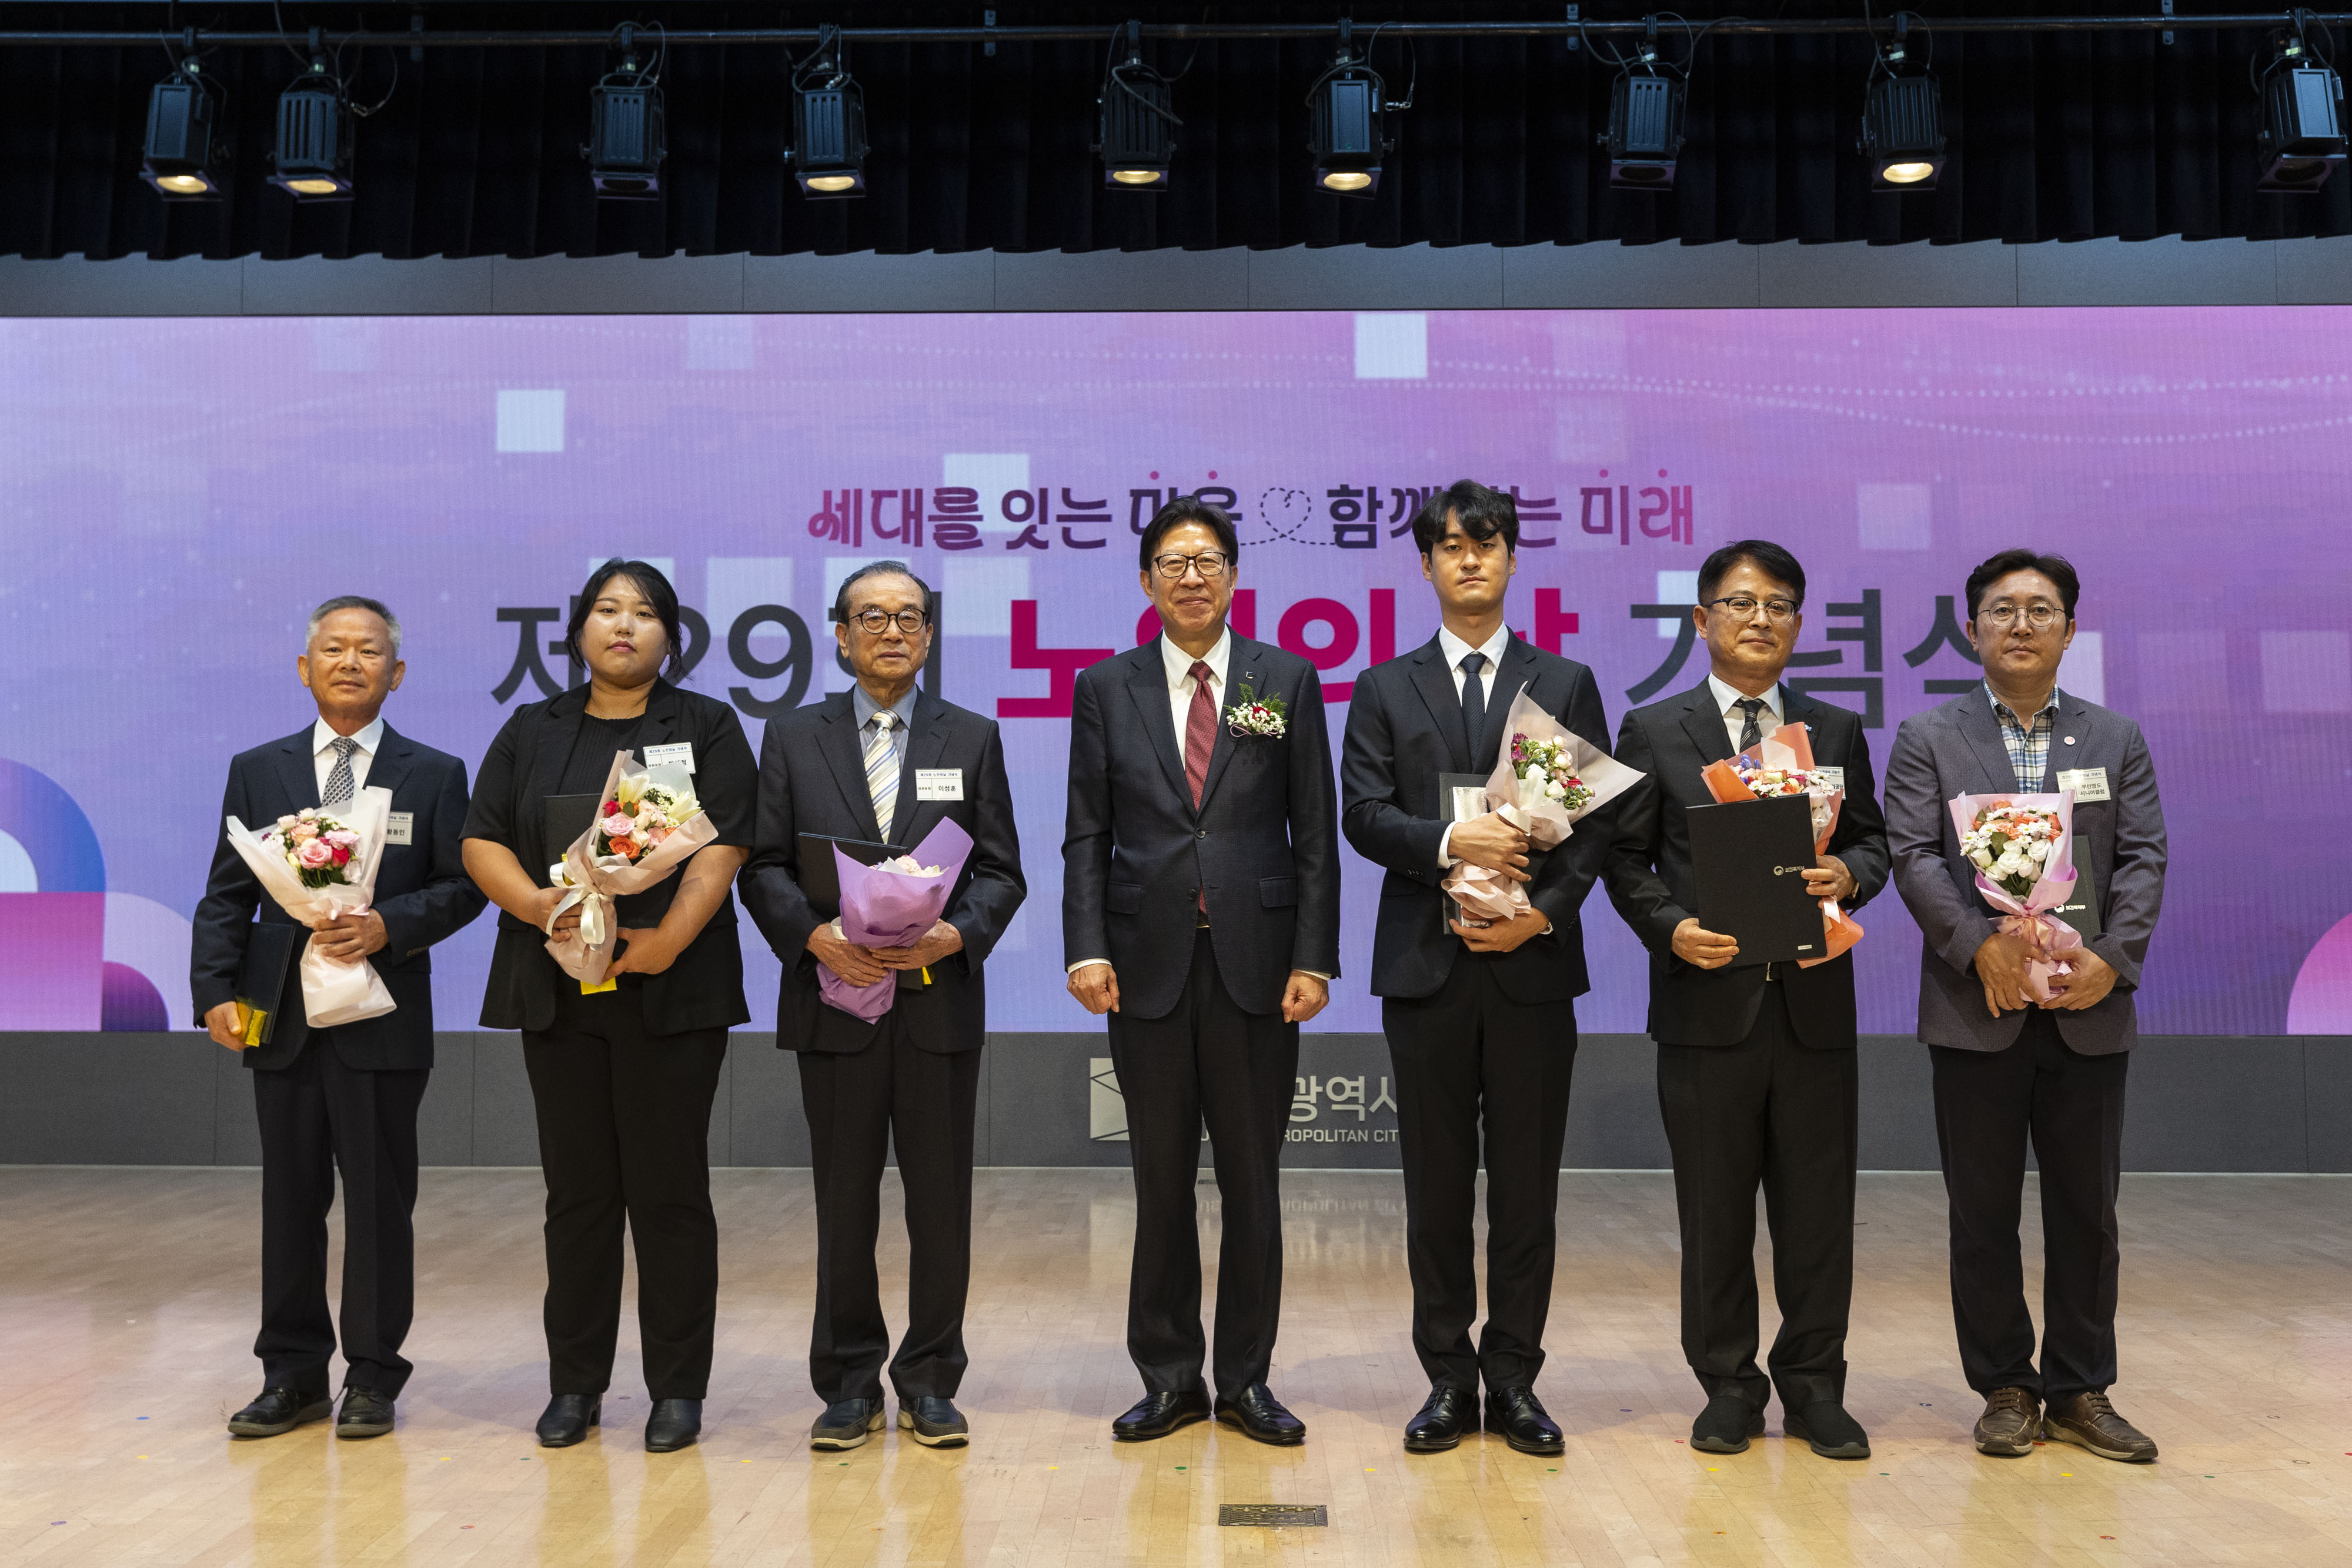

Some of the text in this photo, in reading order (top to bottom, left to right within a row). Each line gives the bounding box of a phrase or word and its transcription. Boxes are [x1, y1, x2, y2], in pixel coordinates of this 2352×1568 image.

[807, 487, 984, 550] 세대를
[1001, 487, 1112, 550] 잇는
[1580, 485, 1693, 546] 미래
